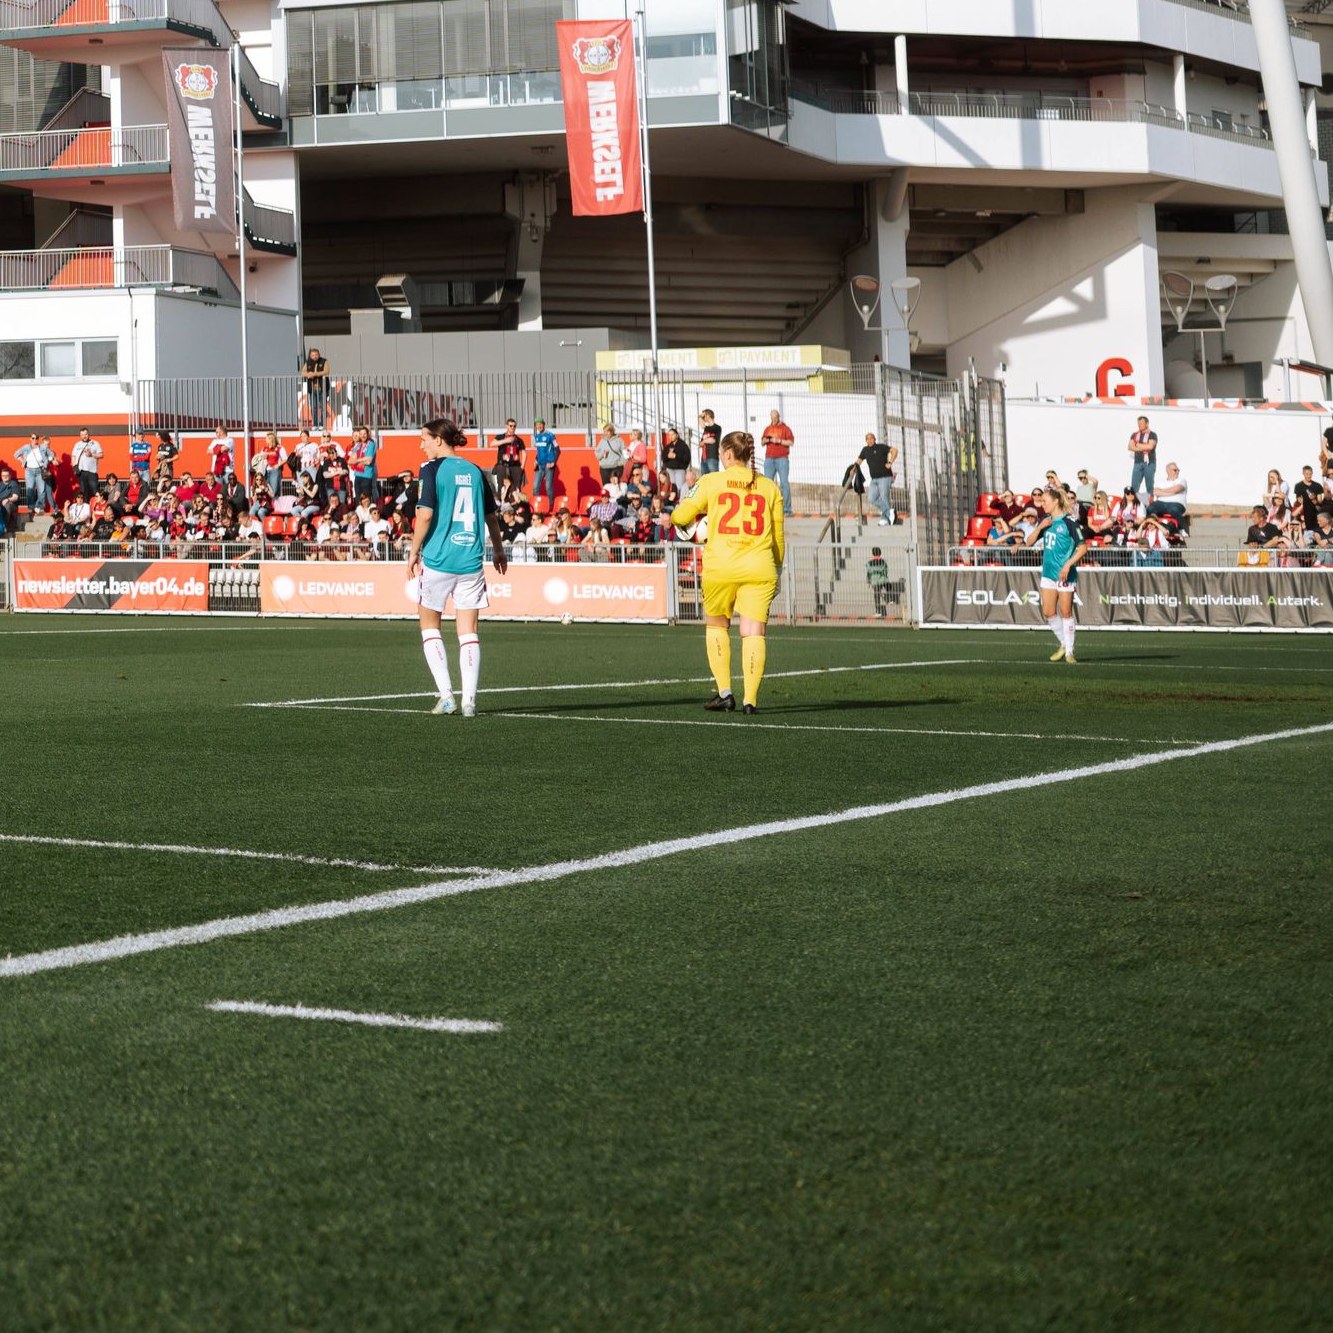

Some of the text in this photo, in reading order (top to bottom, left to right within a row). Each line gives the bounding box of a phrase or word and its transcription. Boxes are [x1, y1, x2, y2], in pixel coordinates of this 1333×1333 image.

[636, 348, 798, 366] PAMENT PAYMENT
[1096, 358, 1135, 404] G
[452, 486, 476, 532] 4
[718, 492, 766, 536] 23
[18, 576, 205, 598] newsletter.bayer04.de
[298, 581, 655, 600] LEDVANCE LEDVANCE
[1099, 594, 1182, 608] Nachhaltig.
[1185, 593, 1264, 607] Individuell.
[1267, 595, 1324, 607] Autark.
